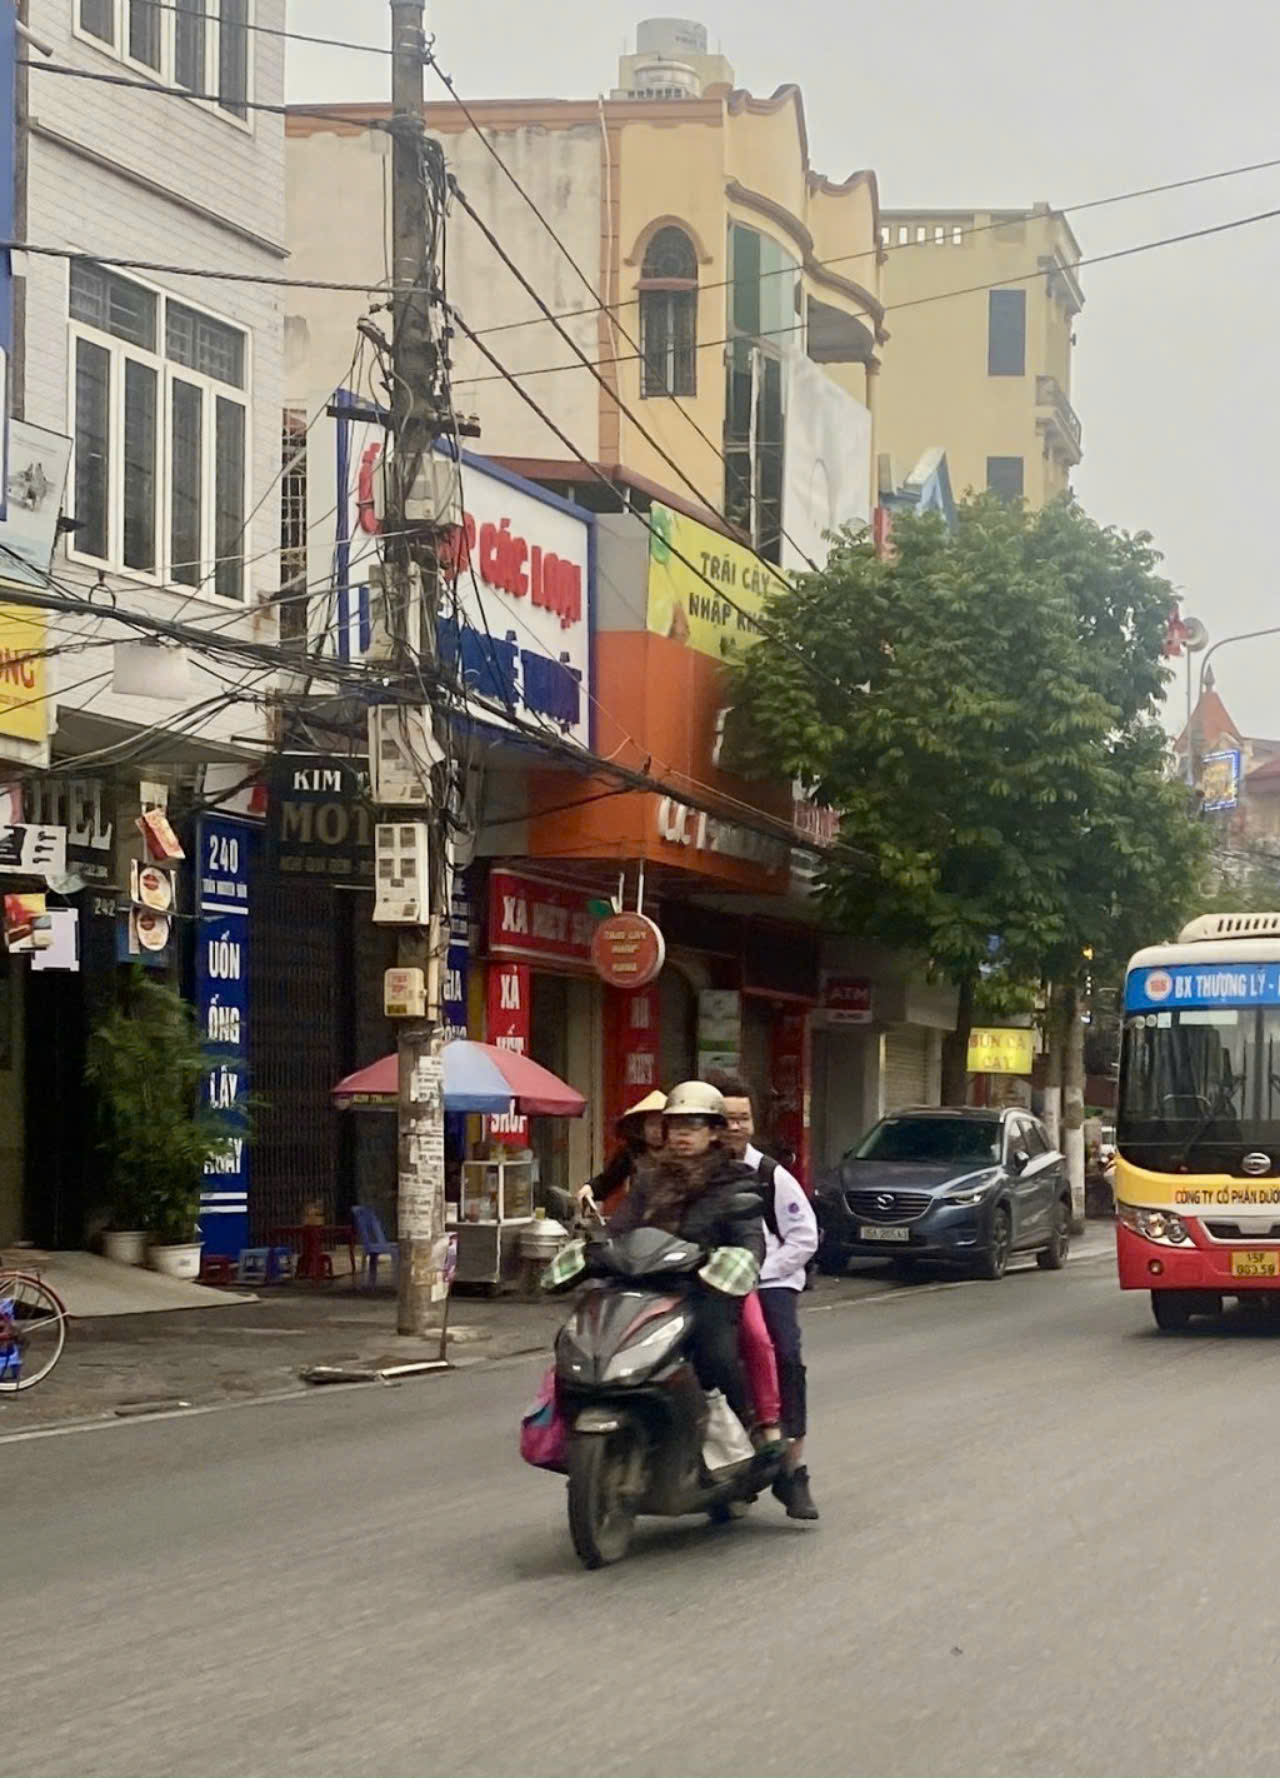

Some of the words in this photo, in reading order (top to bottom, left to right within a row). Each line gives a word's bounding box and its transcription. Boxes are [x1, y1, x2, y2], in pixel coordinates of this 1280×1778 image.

[479, 517, 529, 598] CÁC
[700, 551, 737, 585] TRÁI
[741, 564, 771, 597] CÂY
[293, 769, 342, 792] KIM
[209, 834, 239, 874] 240
[208, 930, 240, 980] UỐN
[500, 964, 521, 1011] XẢ
[1174, 975, 1192, 998] BX
[208, 994, 241, 1044] ỐNG
[1202, 1190, 1214, 1204] TY
